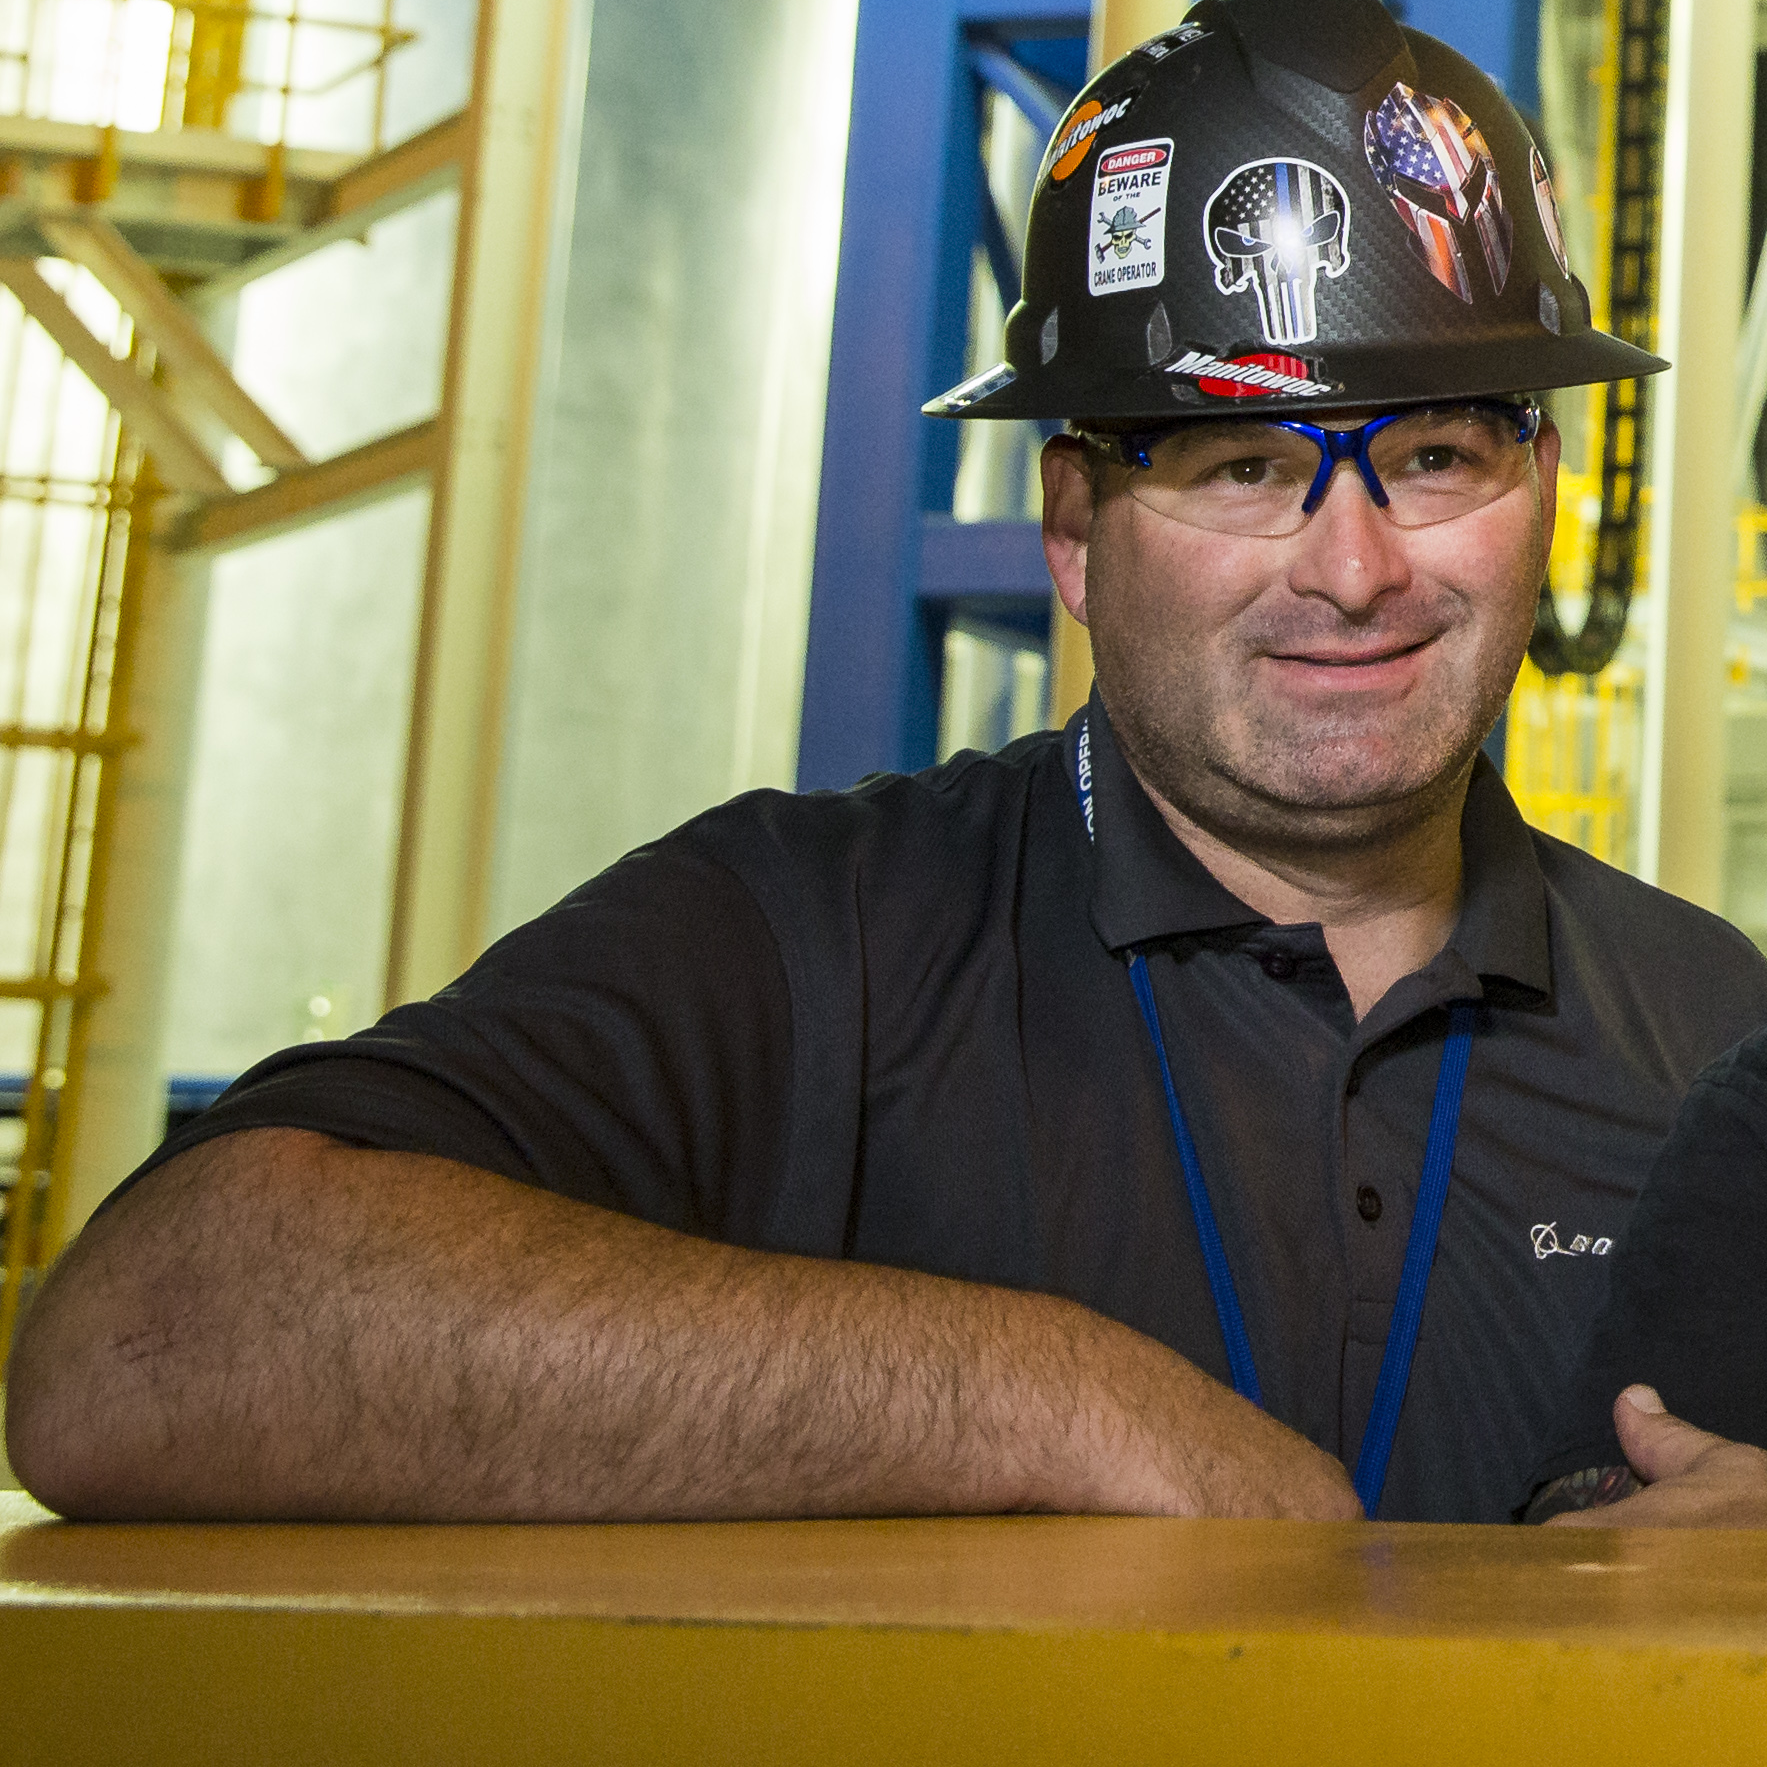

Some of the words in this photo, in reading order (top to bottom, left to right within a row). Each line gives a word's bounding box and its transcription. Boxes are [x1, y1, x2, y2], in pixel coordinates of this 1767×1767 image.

[1107, 151, 1157, 170] DANGER
[1097, 171, 1162, 197] BEWARE
[1125, 192, 1141, 200] THE
[1093, 268, 1116, 287] CRANE
[1116, 261, 1157, 283] OPERATOR
[1164, 350, 1332, 397] Manitowoc
